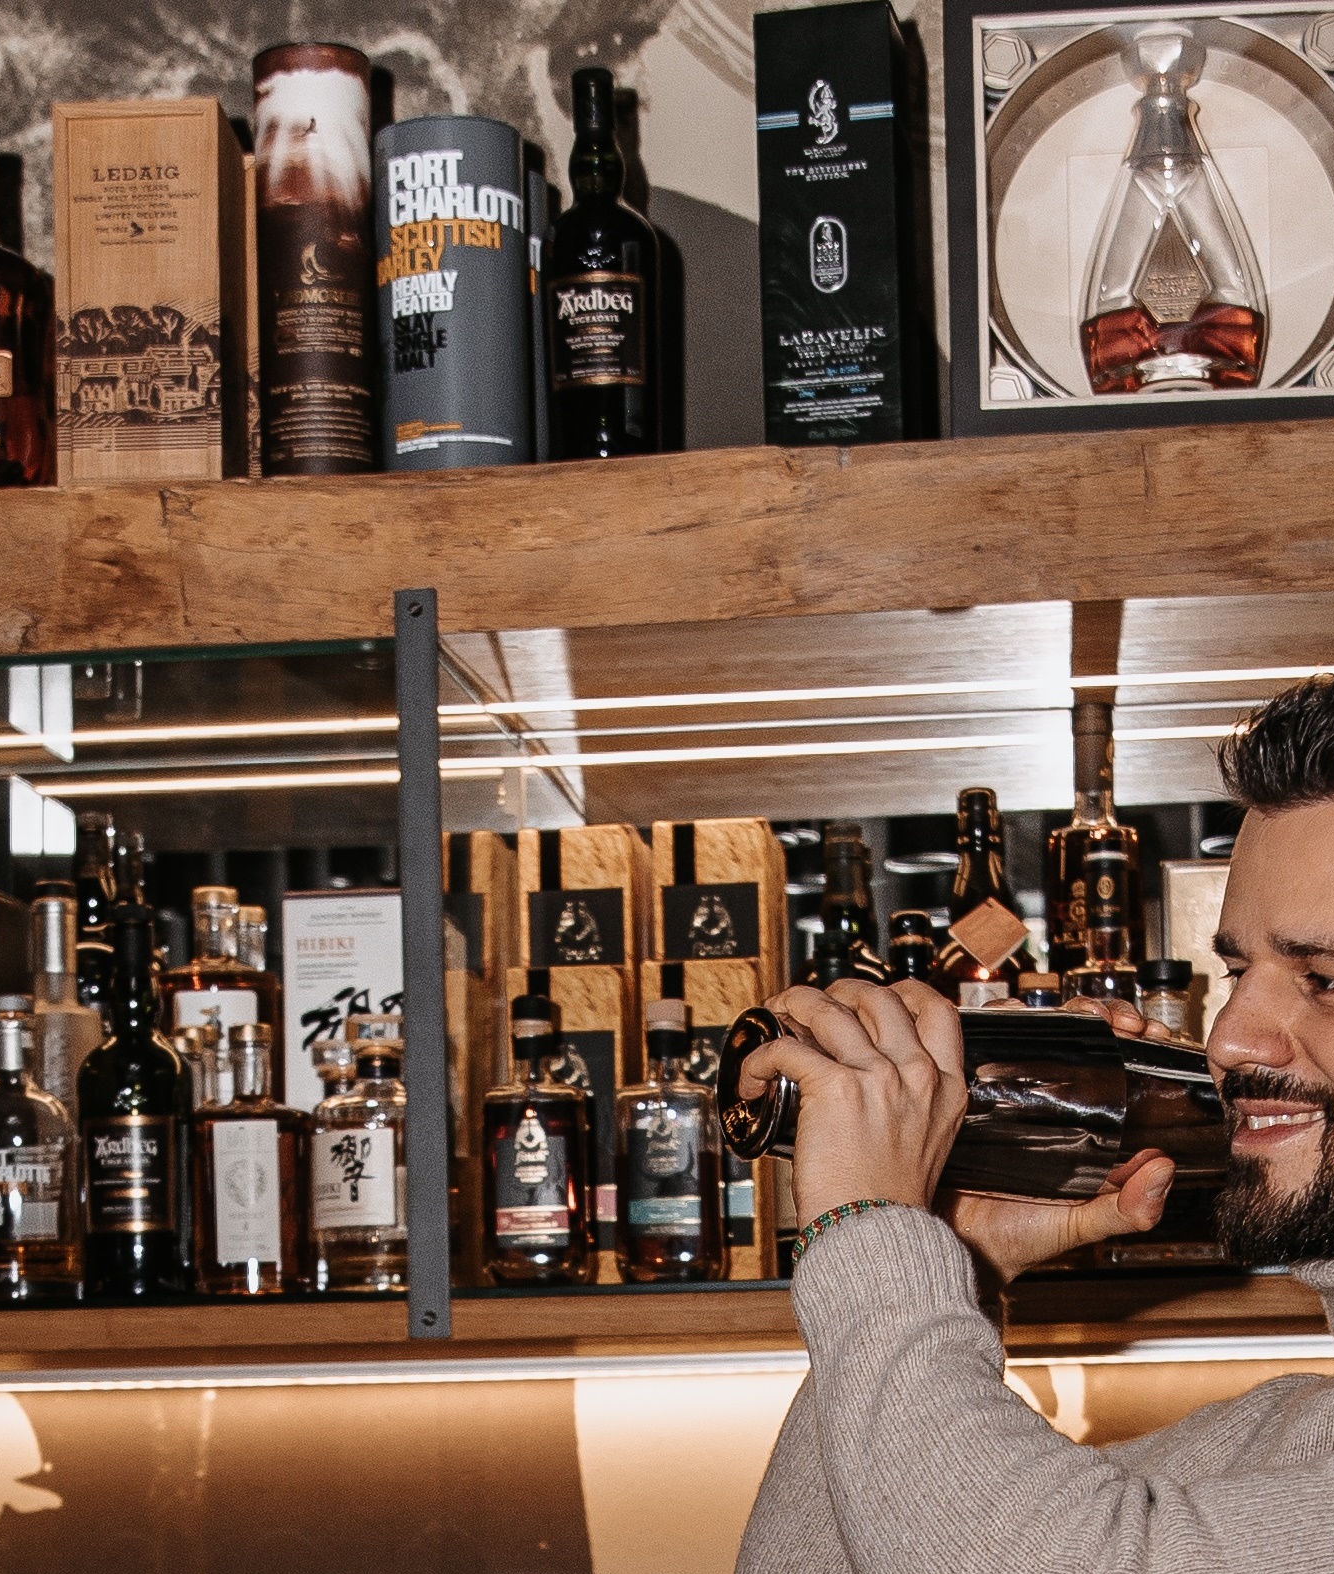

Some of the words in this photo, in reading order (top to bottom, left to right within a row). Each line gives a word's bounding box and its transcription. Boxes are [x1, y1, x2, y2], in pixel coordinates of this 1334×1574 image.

[93, 165, 180, 182] LEDAIG
[388, 150, 463, 196] PORT
[786, 167, 805, 177] THE
[806, 173, 849, 182] EDITION
[95, 212, 133, 222] LIMITED
[136, 210, 178, 220] RELEASE
[390, 186, 524, 234] CHARLOTT
[390, 219, 501, 250] SCOTTISH
[391, 269, 458, 302] HEAVILY
[392, 291, 453, 319] PEATED
[394, 312, 435, 337] ISLAY
[394, 329, 447, 351] SINGLE
[779, 328, 886, 347] LAGAVULIN
[395, 348, 436, 374] MALT
[297, 937, 356, 951] HIBIKI
